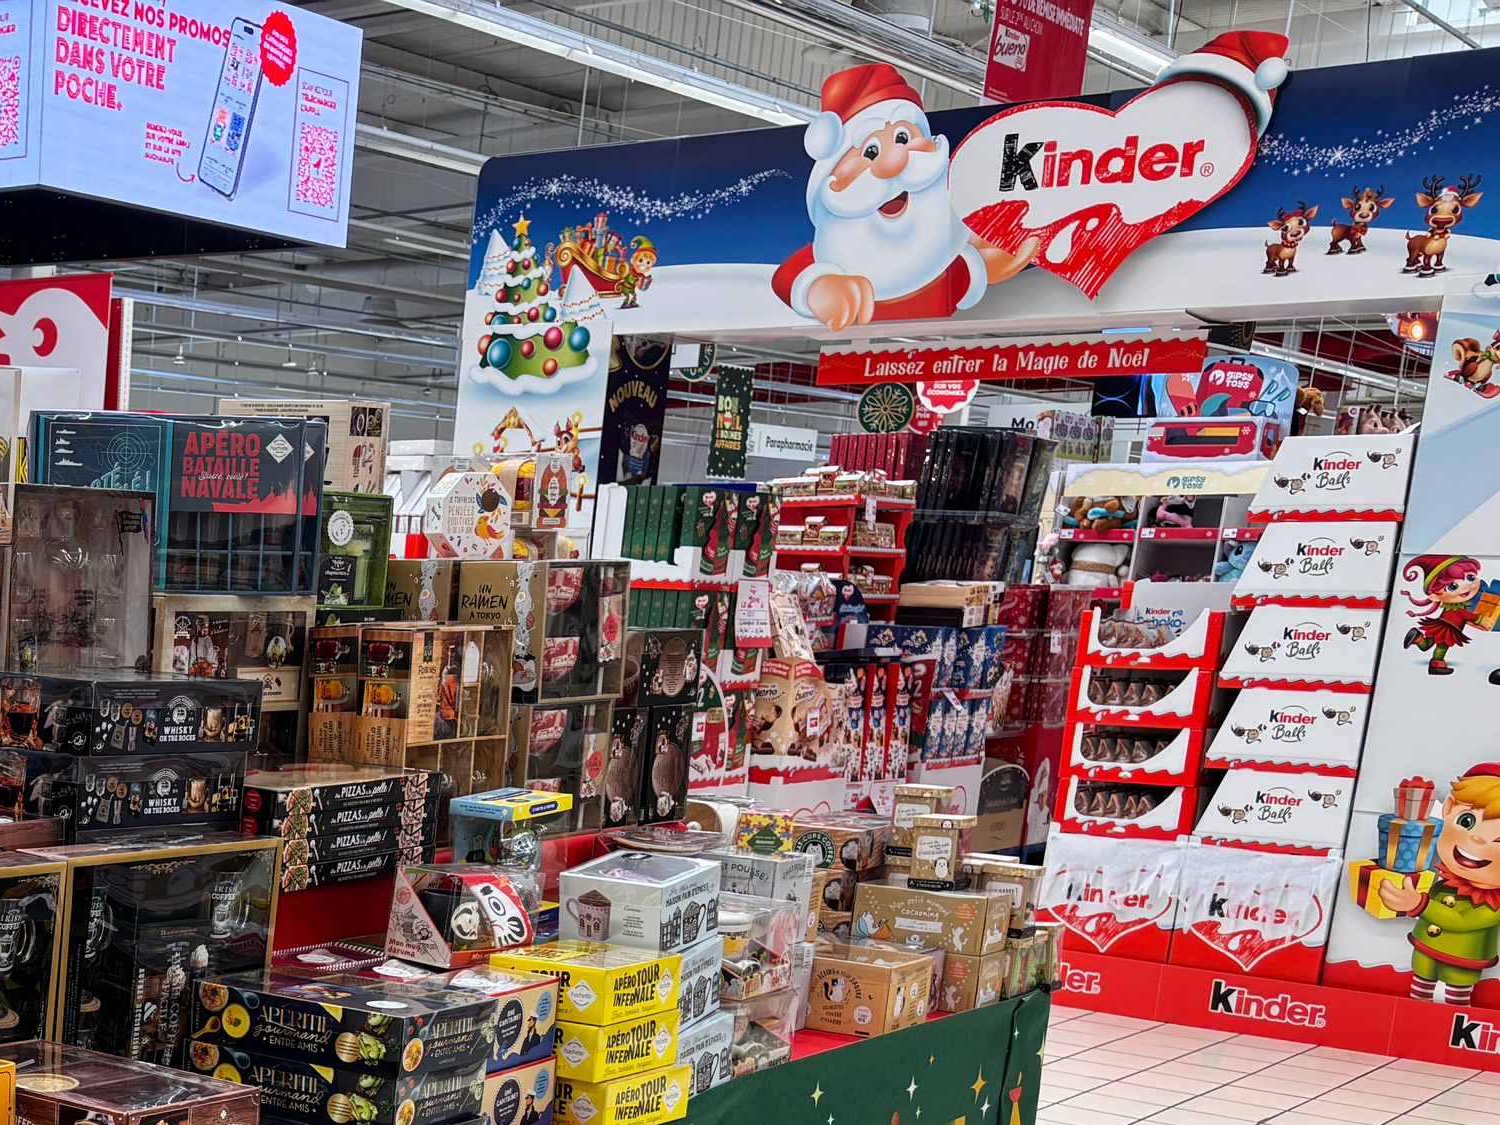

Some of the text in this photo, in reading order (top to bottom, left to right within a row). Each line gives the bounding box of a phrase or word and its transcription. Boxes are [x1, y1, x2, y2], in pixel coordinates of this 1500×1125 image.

[134, 5, 165, 28] NOS
[57, 5, 176, 63] DIRECTEMENT
[55, 37, 165, 90] DANS VOTRE
[999, 133, 1206, 192] Kinder
[932, 354, 984, 374] entrer
[993, 353, 1008, 372] la
[1016, 351, 1069, 372] Magie
[1077, 351, 1098, 369] de
[1107, 348, 1151, 368] Noël
[184, 430, 260, 457] APÉRO
[182, 457, 260, 476] BATAILLE
[1313, 456, 1362, 472] Kinder
[181, 475, 260, 499] NAVALE
[1296, 542, 1345, 557] Kinder
[479, 584, 491, 594] UN
[461, 594, 508, 610] RAMEN
[479, 611, 501, 620] TOKYO
[1283, 626, 1331, 641] Kinder
[1269, 709, 1317, 725] Kinder
[164, 725, 194, 735] WHISKY
[341, 784, 366, 798] PIZZAS
[1255, 790, 1303, 807] Kinder
[148, 797, 177, 807] WHISKY
[336, 812, 362, 825] PIZZAS
[336, 835, 362, 849] PIZZAS
[336, 858, 361, 872] PIZZAS
[635, 963, 660, 982] TOUR
[613, 982, 656, 1008] INFERNALE
[1209, 979, 1315, 1026] Kinder
[631, 1020, 656, 1041] TOUR
[269, 1035, 318, 1053] ENTRE AMIS
[606, 1040, 652, 1064] INFERNALE
[640, 1075, 667, 1096] TOUR
[614, 1097, 660, 1121] INFERNALE
